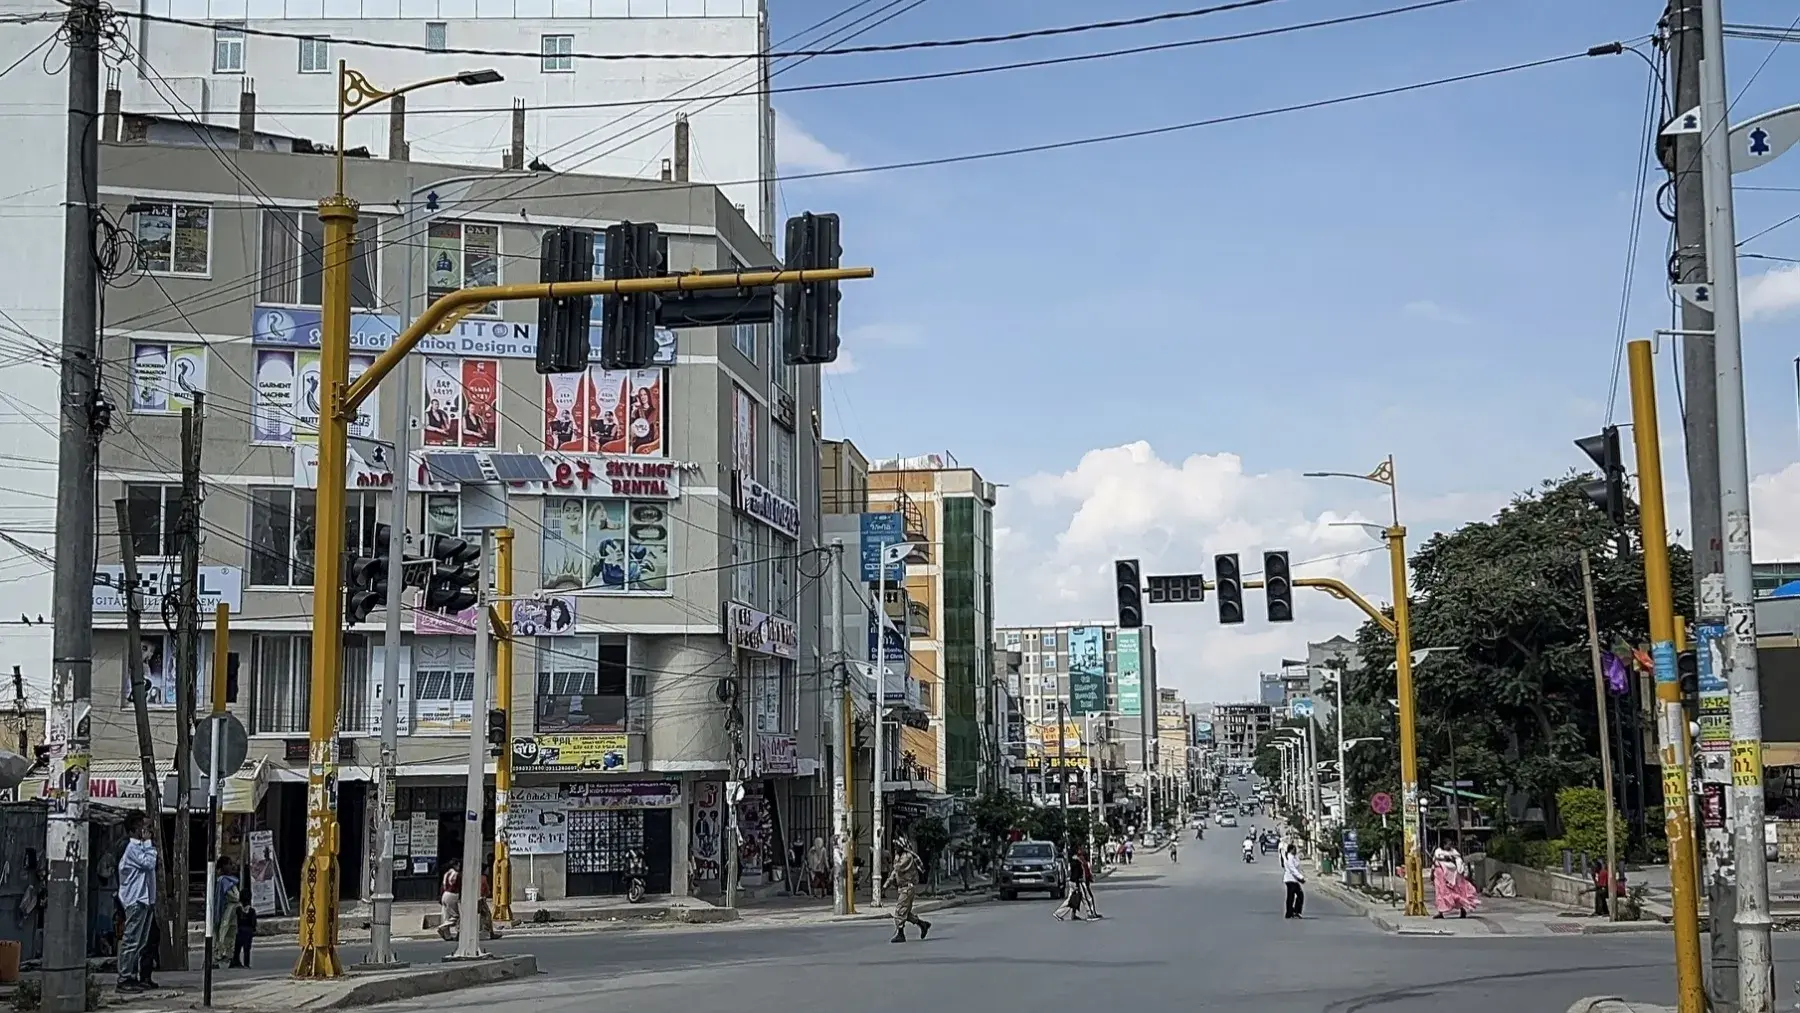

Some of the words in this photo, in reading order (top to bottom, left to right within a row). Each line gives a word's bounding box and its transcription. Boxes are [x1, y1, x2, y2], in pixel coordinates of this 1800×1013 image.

[461, 337, 517, 355] Design
[611, 478, 669, 496] DENTAL
[512, 742, 537, 755] GYB
